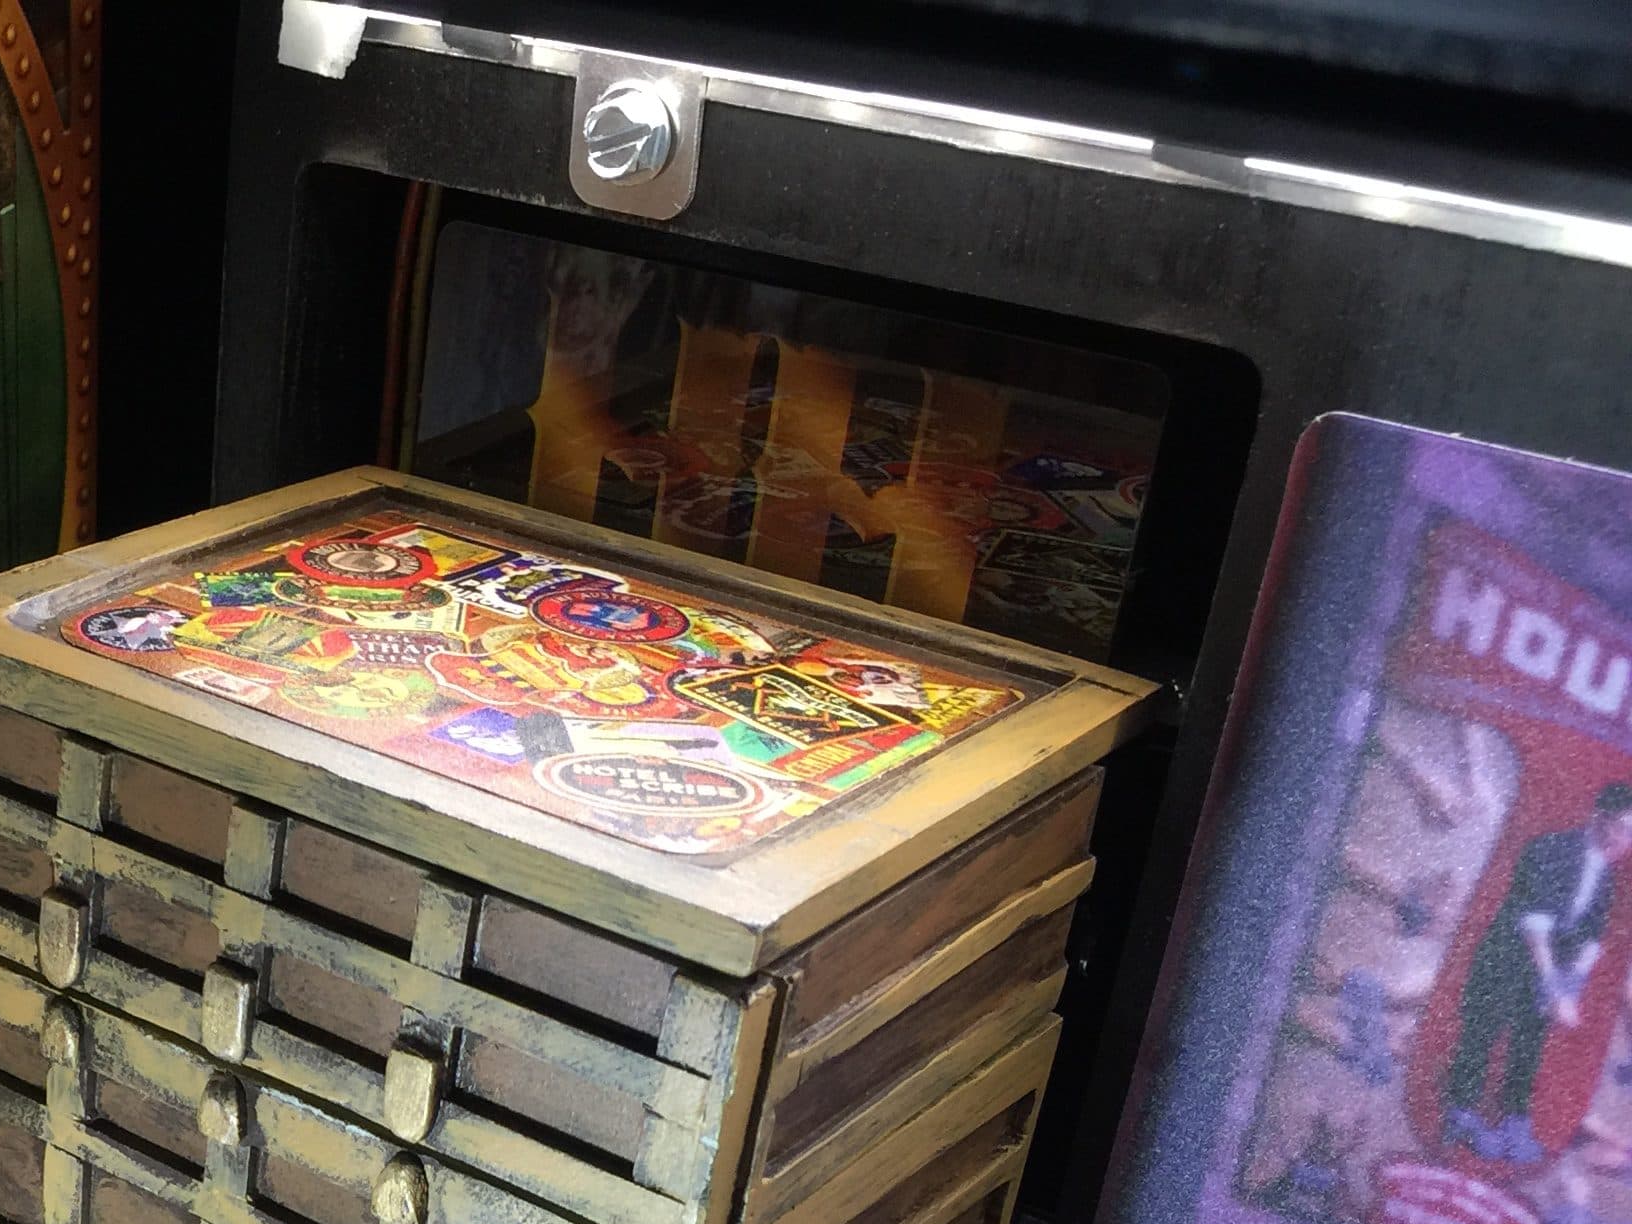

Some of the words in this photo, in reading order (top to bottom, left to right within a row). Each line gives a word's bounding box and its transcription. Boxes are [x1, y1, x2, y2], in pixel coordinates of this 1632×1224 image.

[1433, 568, 1632, 717] HOU
[572, 763, 679, 784] HOTEL
[618, 777, 739, 799] SCRIBE
